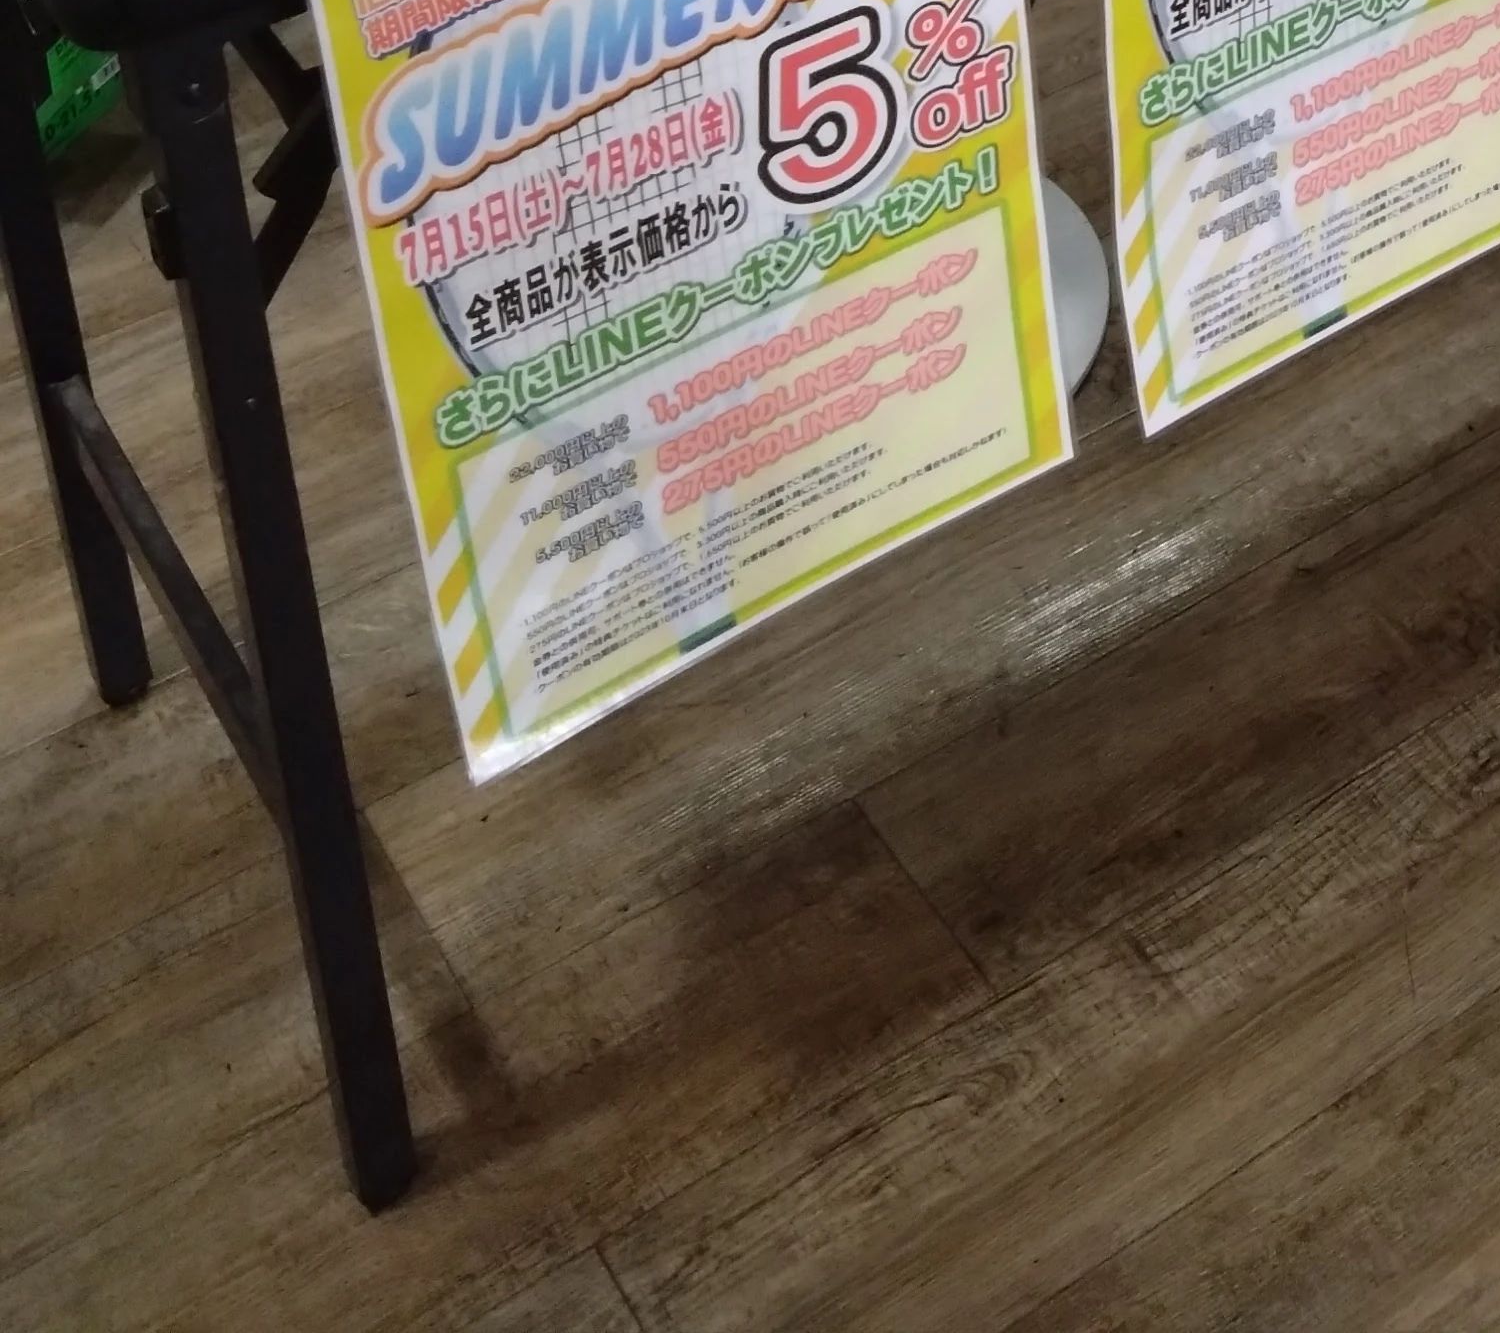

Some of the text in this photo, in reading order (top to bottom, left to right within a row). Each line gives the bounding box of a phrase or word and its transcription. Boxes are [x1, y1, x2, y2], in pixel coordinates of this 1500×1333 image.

[757, 3, 899, 211] 5
[910, 40, 1014, 149] off
[463, 182, 748, 345] 全商品が表示価格から
[647, 248, 978, 424] 1,100円のLINEクーポン
[656, 305, 962, 473] 550円のLINEクーポン
[661, 343, 966, 515] 275円のLINEクーポン
